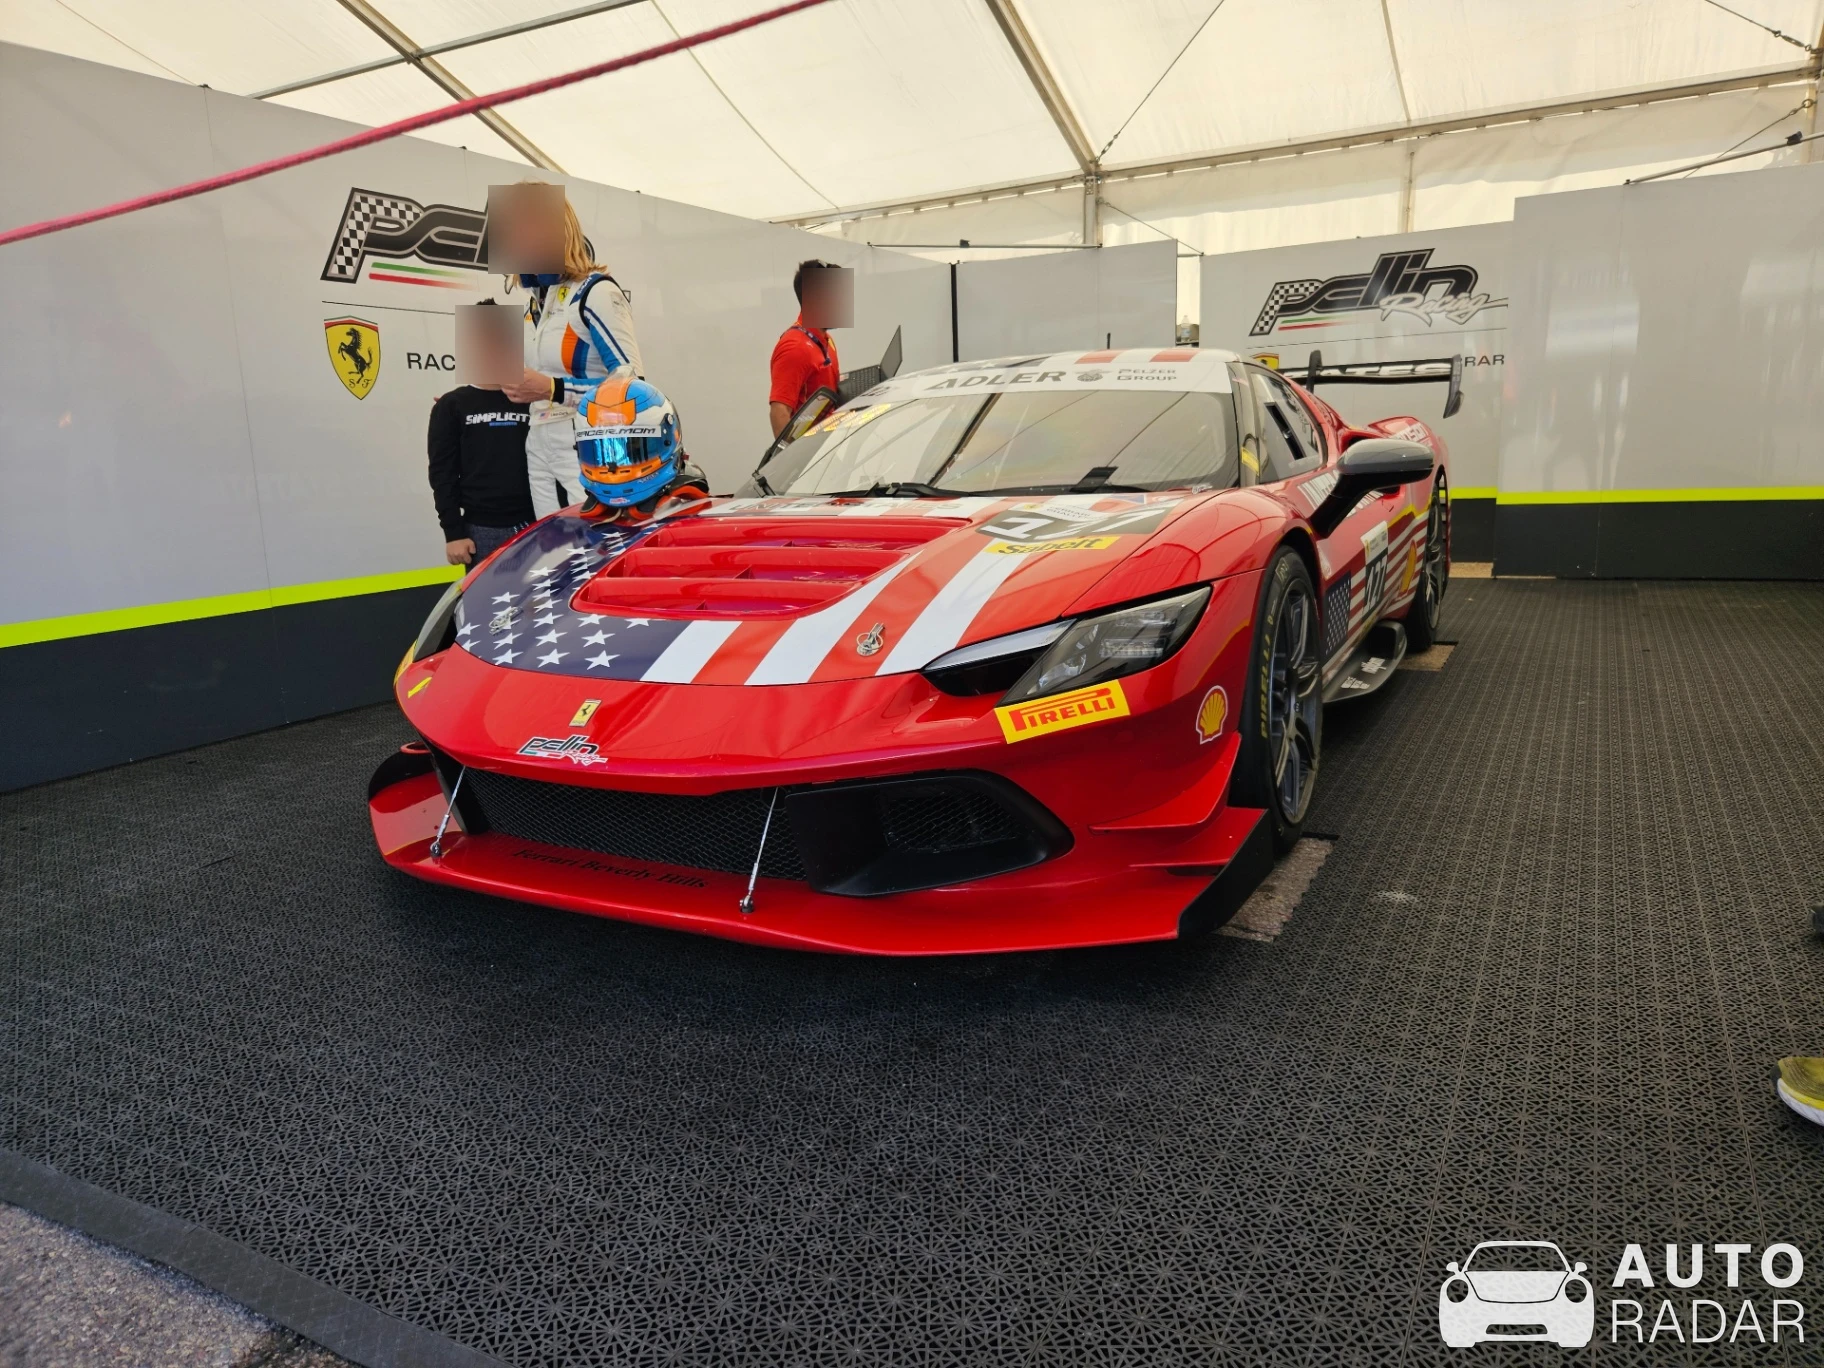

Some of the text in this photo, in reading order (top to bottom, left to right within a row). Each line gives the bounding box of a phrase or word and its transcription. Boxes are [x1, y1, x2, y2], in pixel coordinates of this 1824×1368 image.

[406, 351, 456, 372] RAC
[1463, 354, 1505, 368] RAR
[925, 371, 1067, 391] ADLER
[1260, 634, 1272, 738] PIRELLI
[1007, 686, 1116, 732] PIRELLI
[512, 849, 709, 889] Ferrari Beverly Hills
